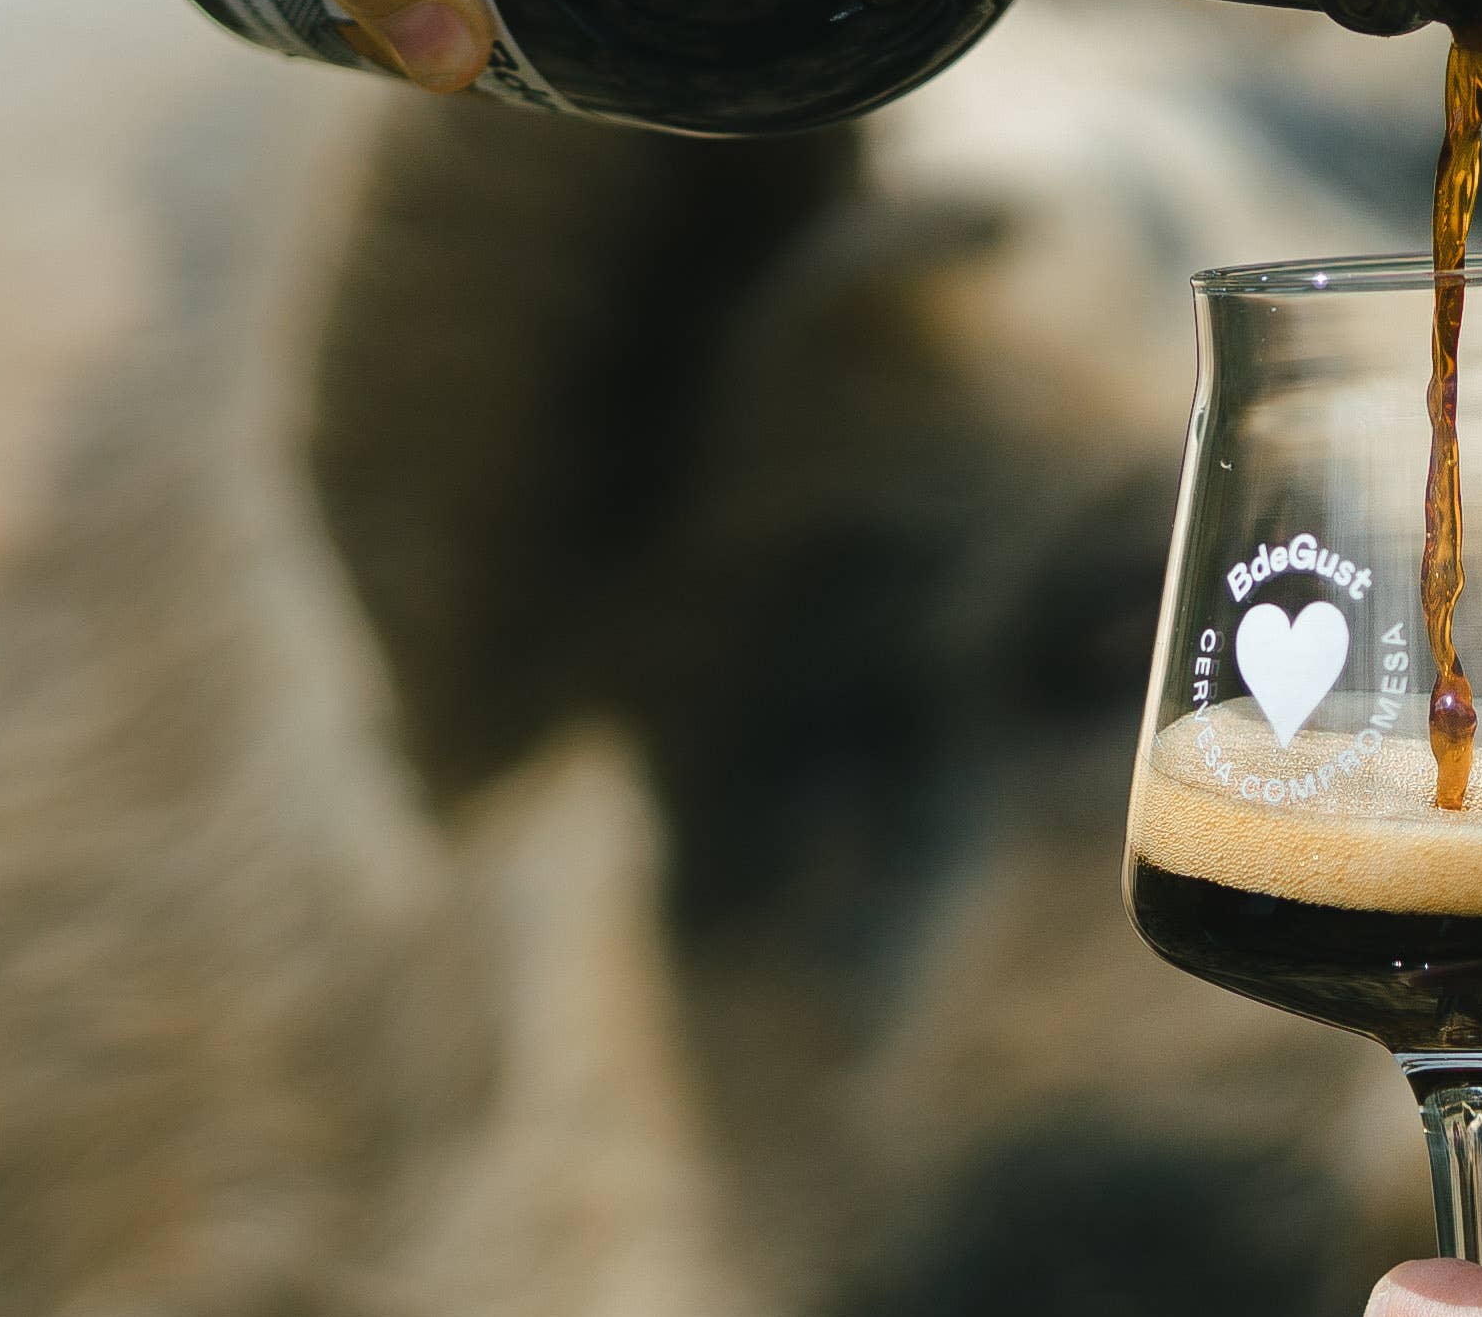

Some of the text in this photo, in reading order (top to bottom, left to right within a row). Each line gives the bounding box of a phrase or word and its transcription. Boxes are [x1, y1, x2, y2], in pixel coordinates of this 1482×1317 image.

[1227, 532, 1373, 602] BdeGust
[1193, 622, 1411, 807] CERVESA COMPROMESA
